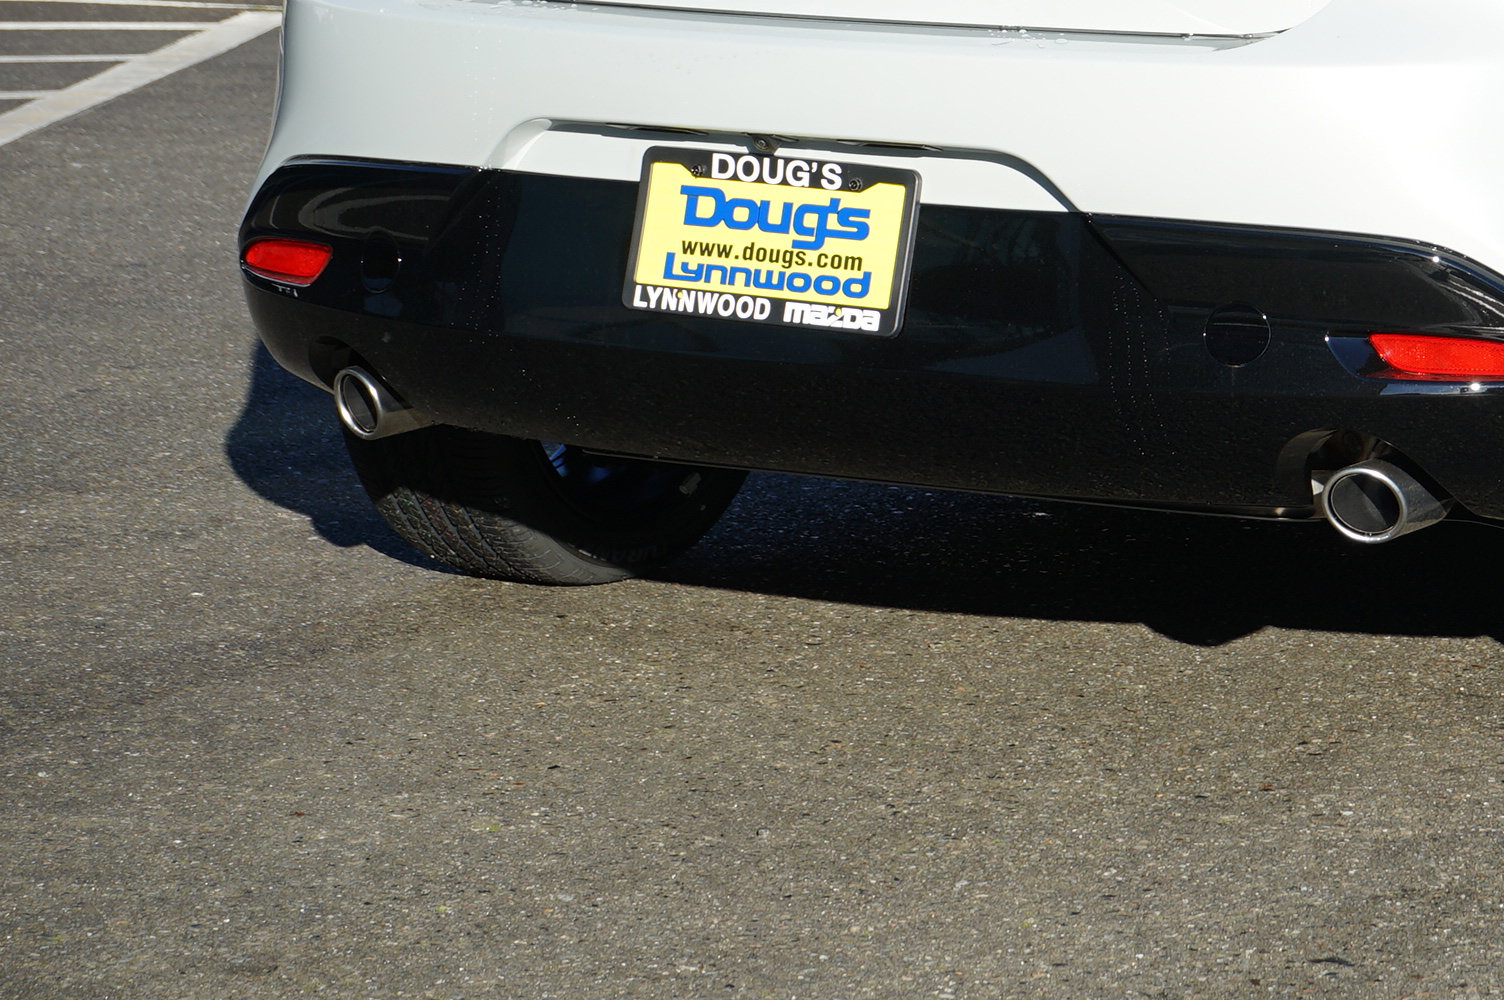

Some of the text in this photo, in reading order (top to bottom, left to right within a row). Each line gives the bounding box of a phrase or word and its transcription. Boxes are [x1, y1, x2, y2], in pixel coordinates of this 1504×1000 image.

[711, 153, 843, 190] DOUG'S
[682, 240, 863, 271] www.dougs.com
[663, 252, 872, 299] Lynnwood
[633, 285, 771, 320] LYNNWOOD
